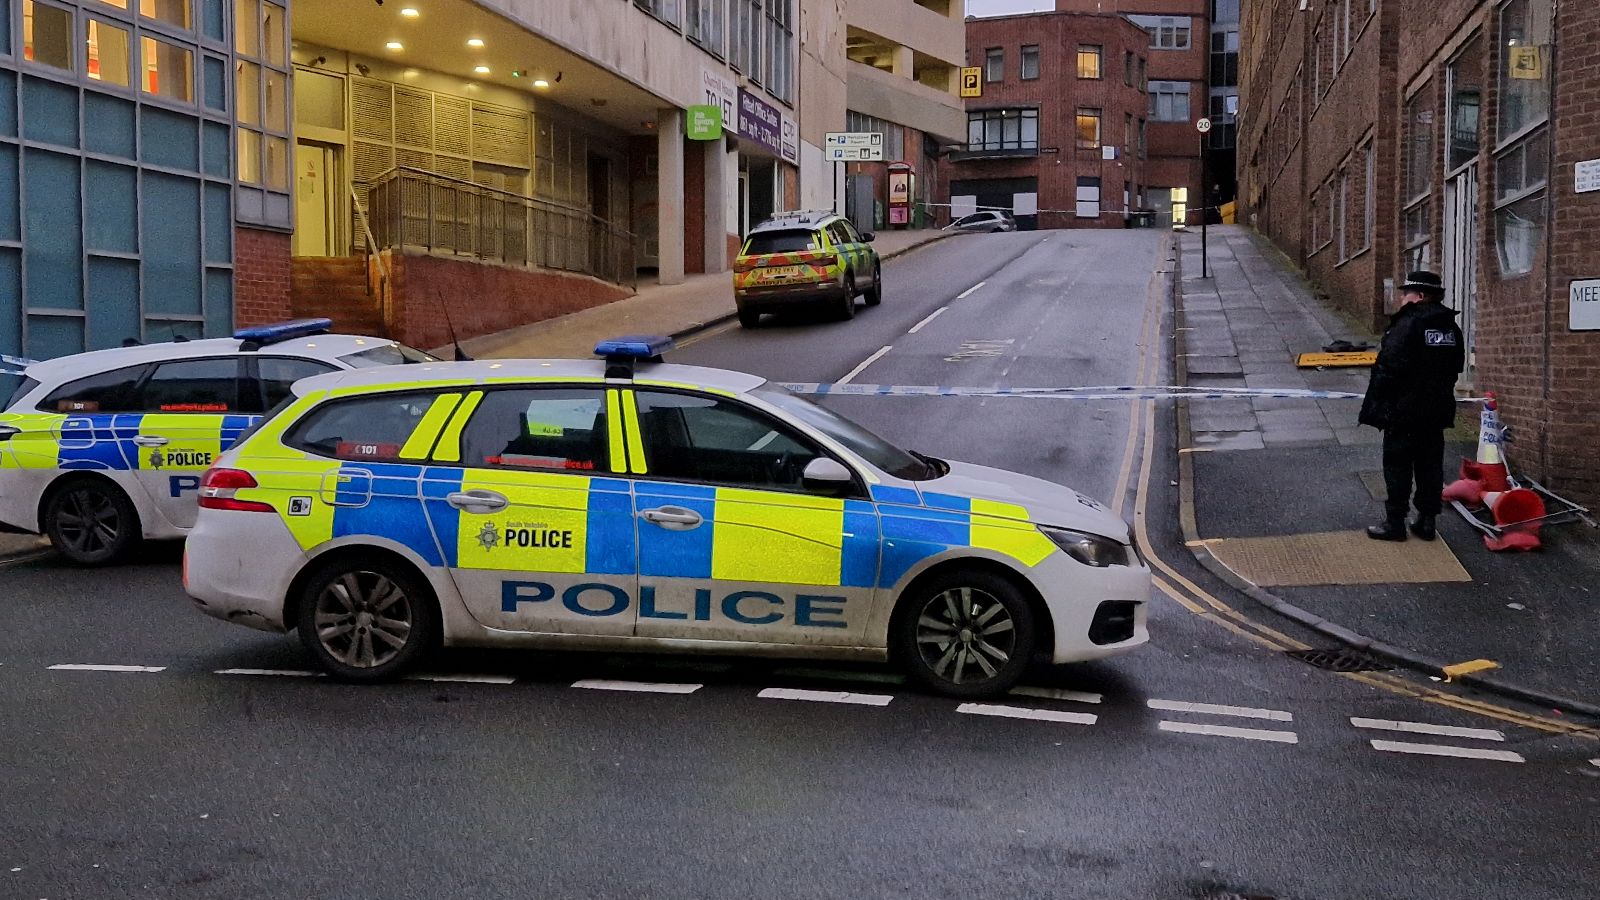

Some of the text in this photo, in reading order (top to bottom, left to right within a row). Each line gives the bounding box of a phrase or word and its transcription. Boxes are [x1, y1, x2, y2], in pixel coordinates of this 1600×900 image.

[1199, 121, 1210, 129] 20
[1573, 286, 1600, 302] MEE
[1427, 331, 1456, 344] POLICE
[361, 445, 378, 455] 101
[167, 452, 211, 467] POLICE
[505, 529, 572, 549] POLICE
[501, 579, 848, 629] POLICE
